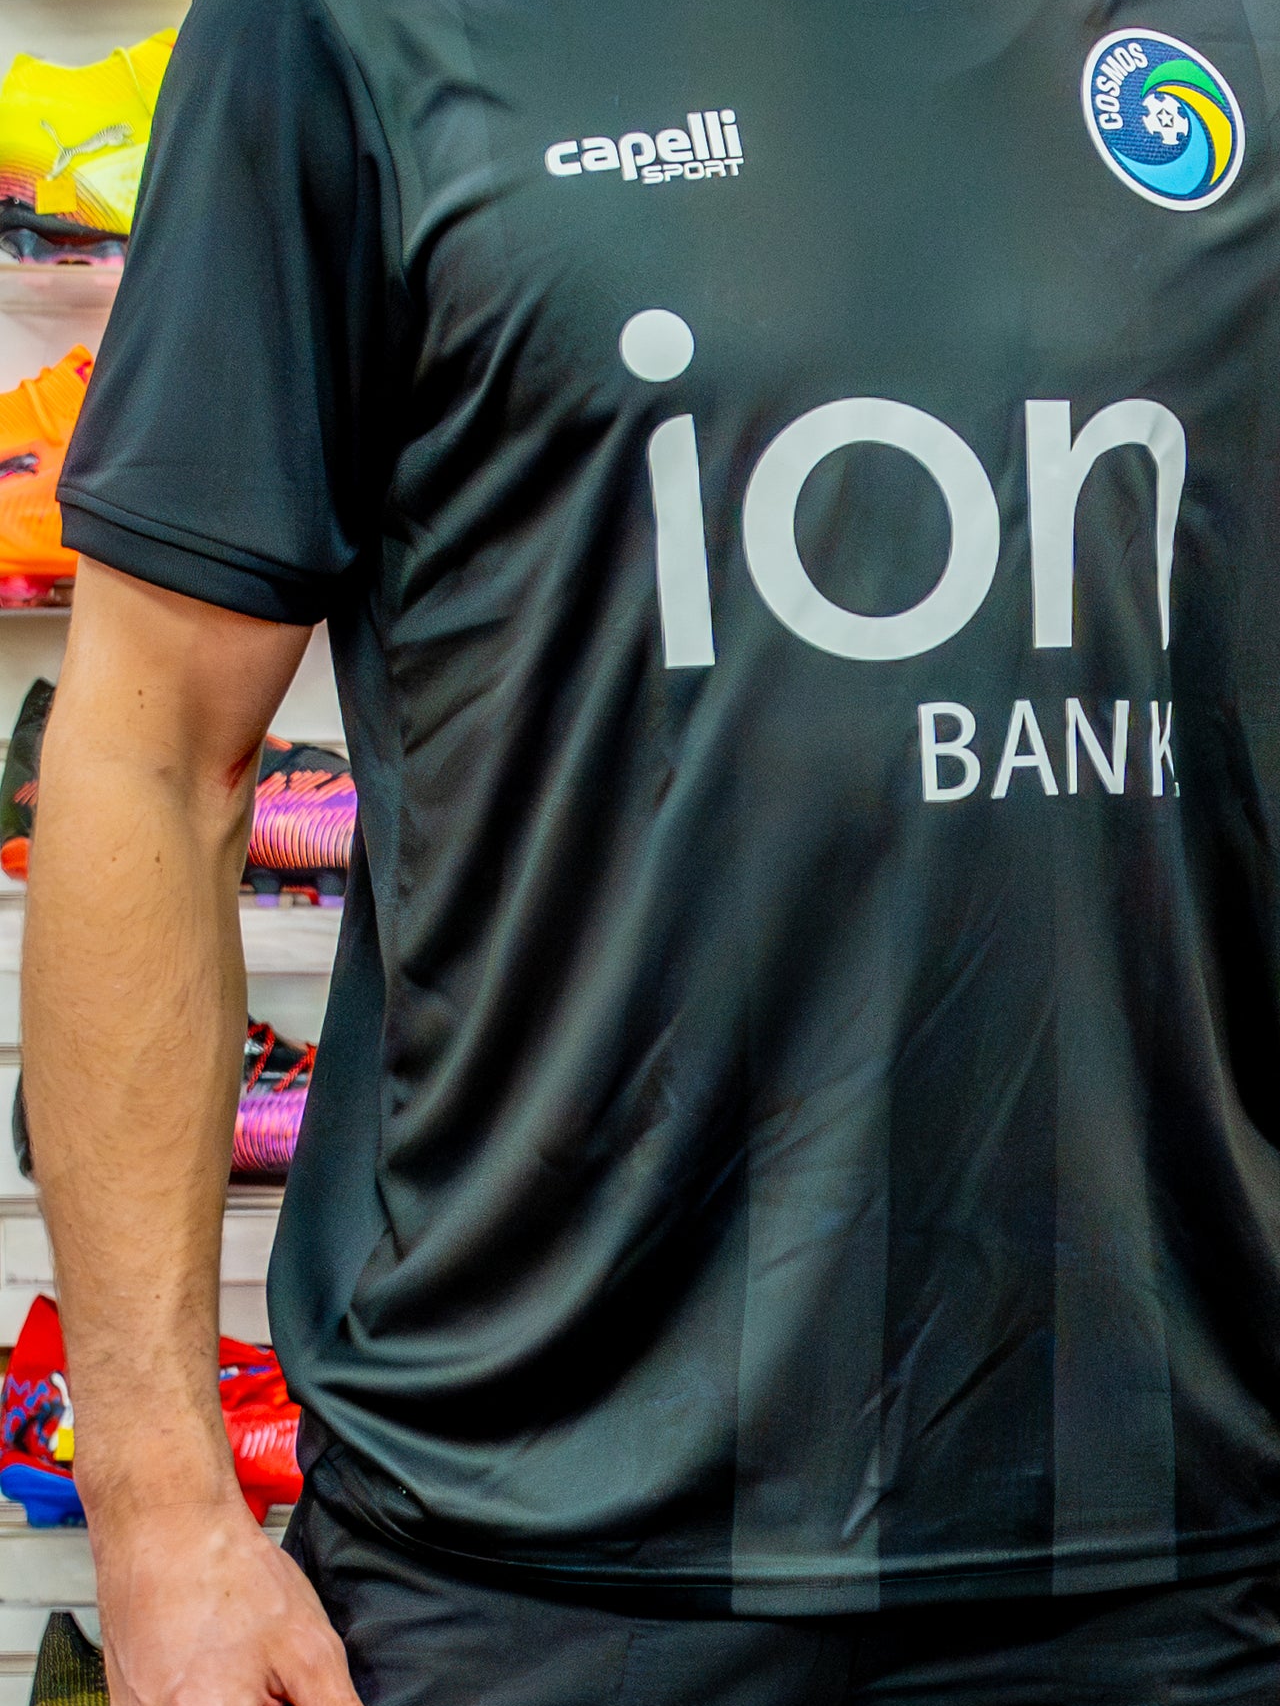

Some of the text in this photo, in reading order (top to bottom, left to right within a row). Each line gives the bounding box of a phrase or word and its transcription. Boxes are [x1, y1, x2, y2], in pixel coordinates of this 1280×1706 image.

[1099, 41, 1149, 131] COSMOS
[544, 109, 743, 182] capelli
[640, 156, 744, 185] SPORT
[619, 308, 1187, 670] ion
[918, 697, 1180, 804] BANK
